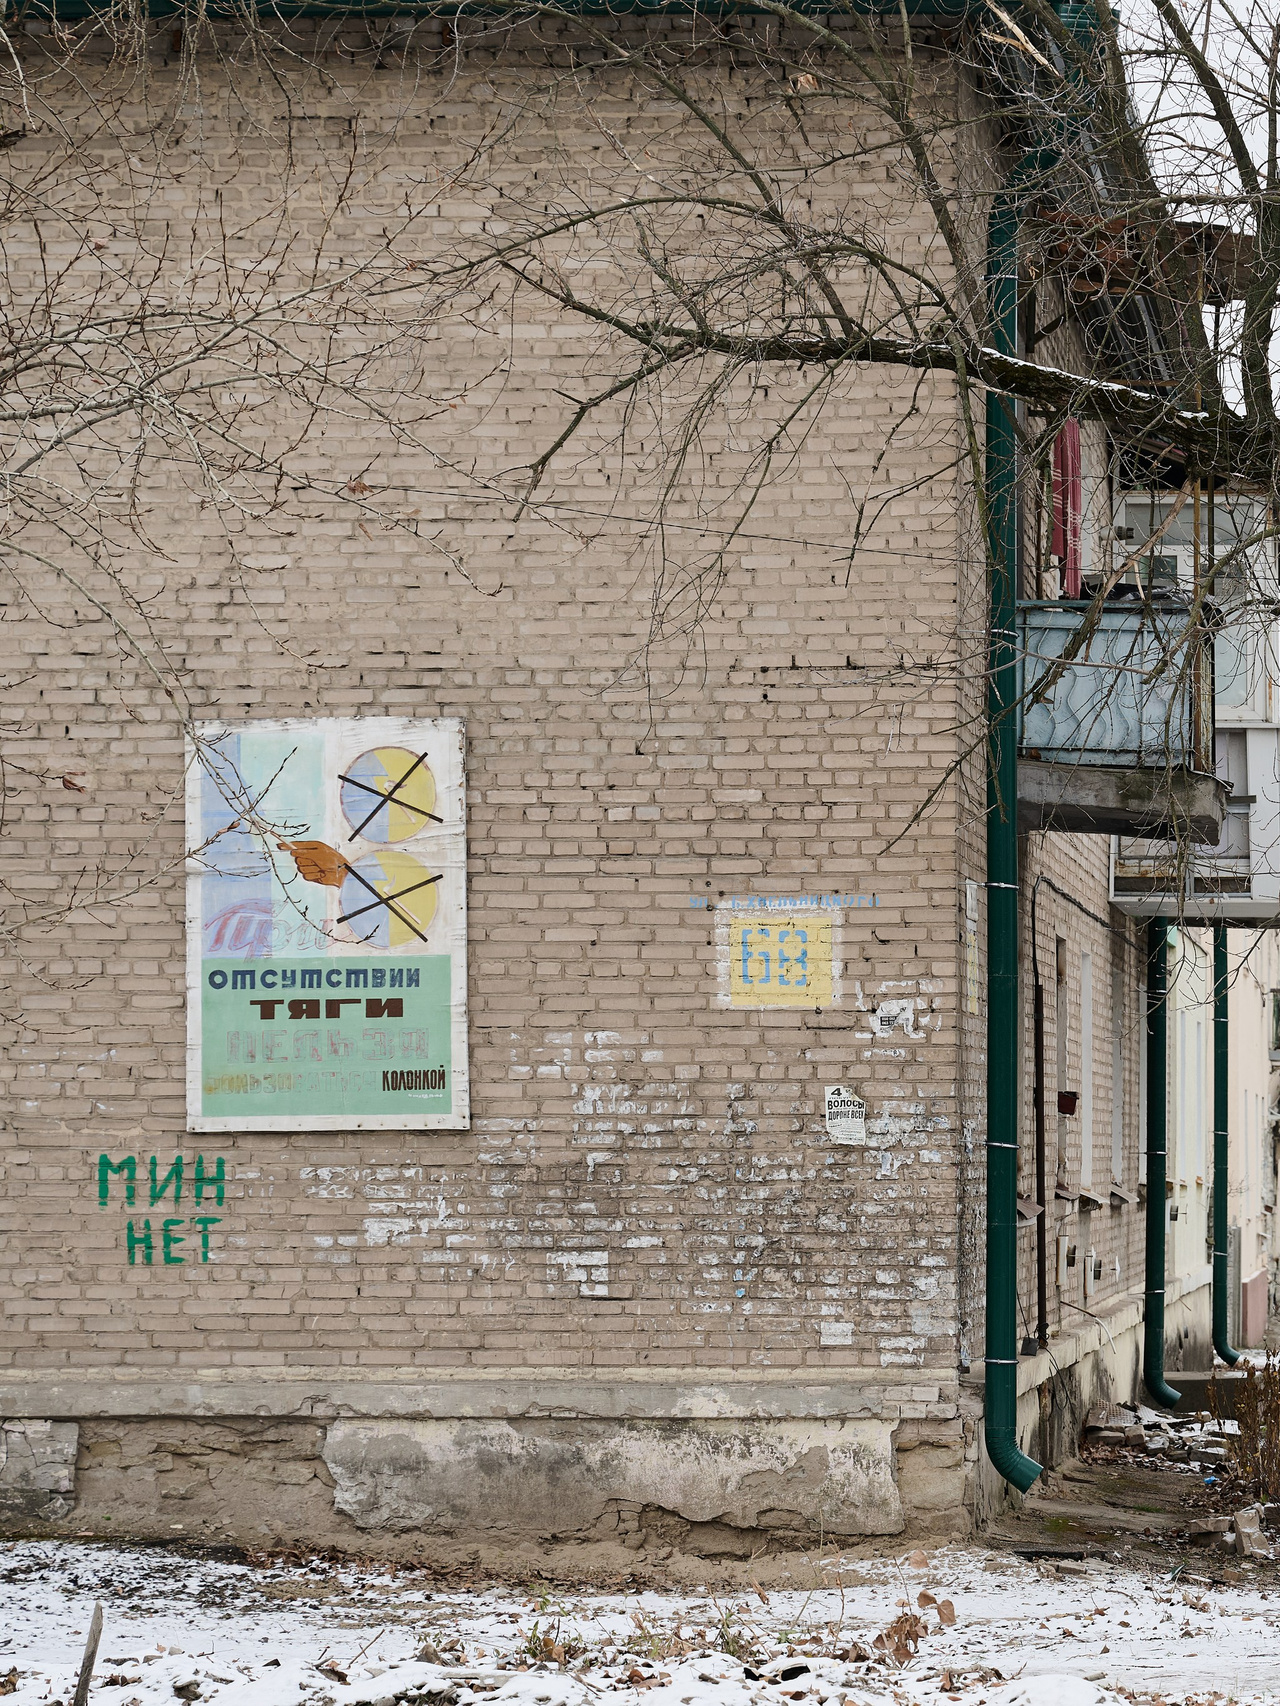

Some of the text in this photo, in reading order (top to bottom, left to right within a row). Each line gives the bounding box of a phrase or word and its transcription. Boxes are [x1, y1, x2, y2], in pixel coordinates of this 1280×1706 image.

[741, 928, 808, 986] 68
[208, 968, 420, 990] ОТСУТСТВИИ
[249, 998, 404, 1020] ТЯГИ
[226, 1027, 430, 1064] НЕЛЬЗЯ
[382, 1064, 446, 1091] КОЛОНКОЙ
[827, 1099, 865, 1110] ВОЛОСЫ
[830, 1087, 843, 1097] 4
[98, 1154, 226, 1208] МИН
[127, 1217, 223, 1265] НЕТ
